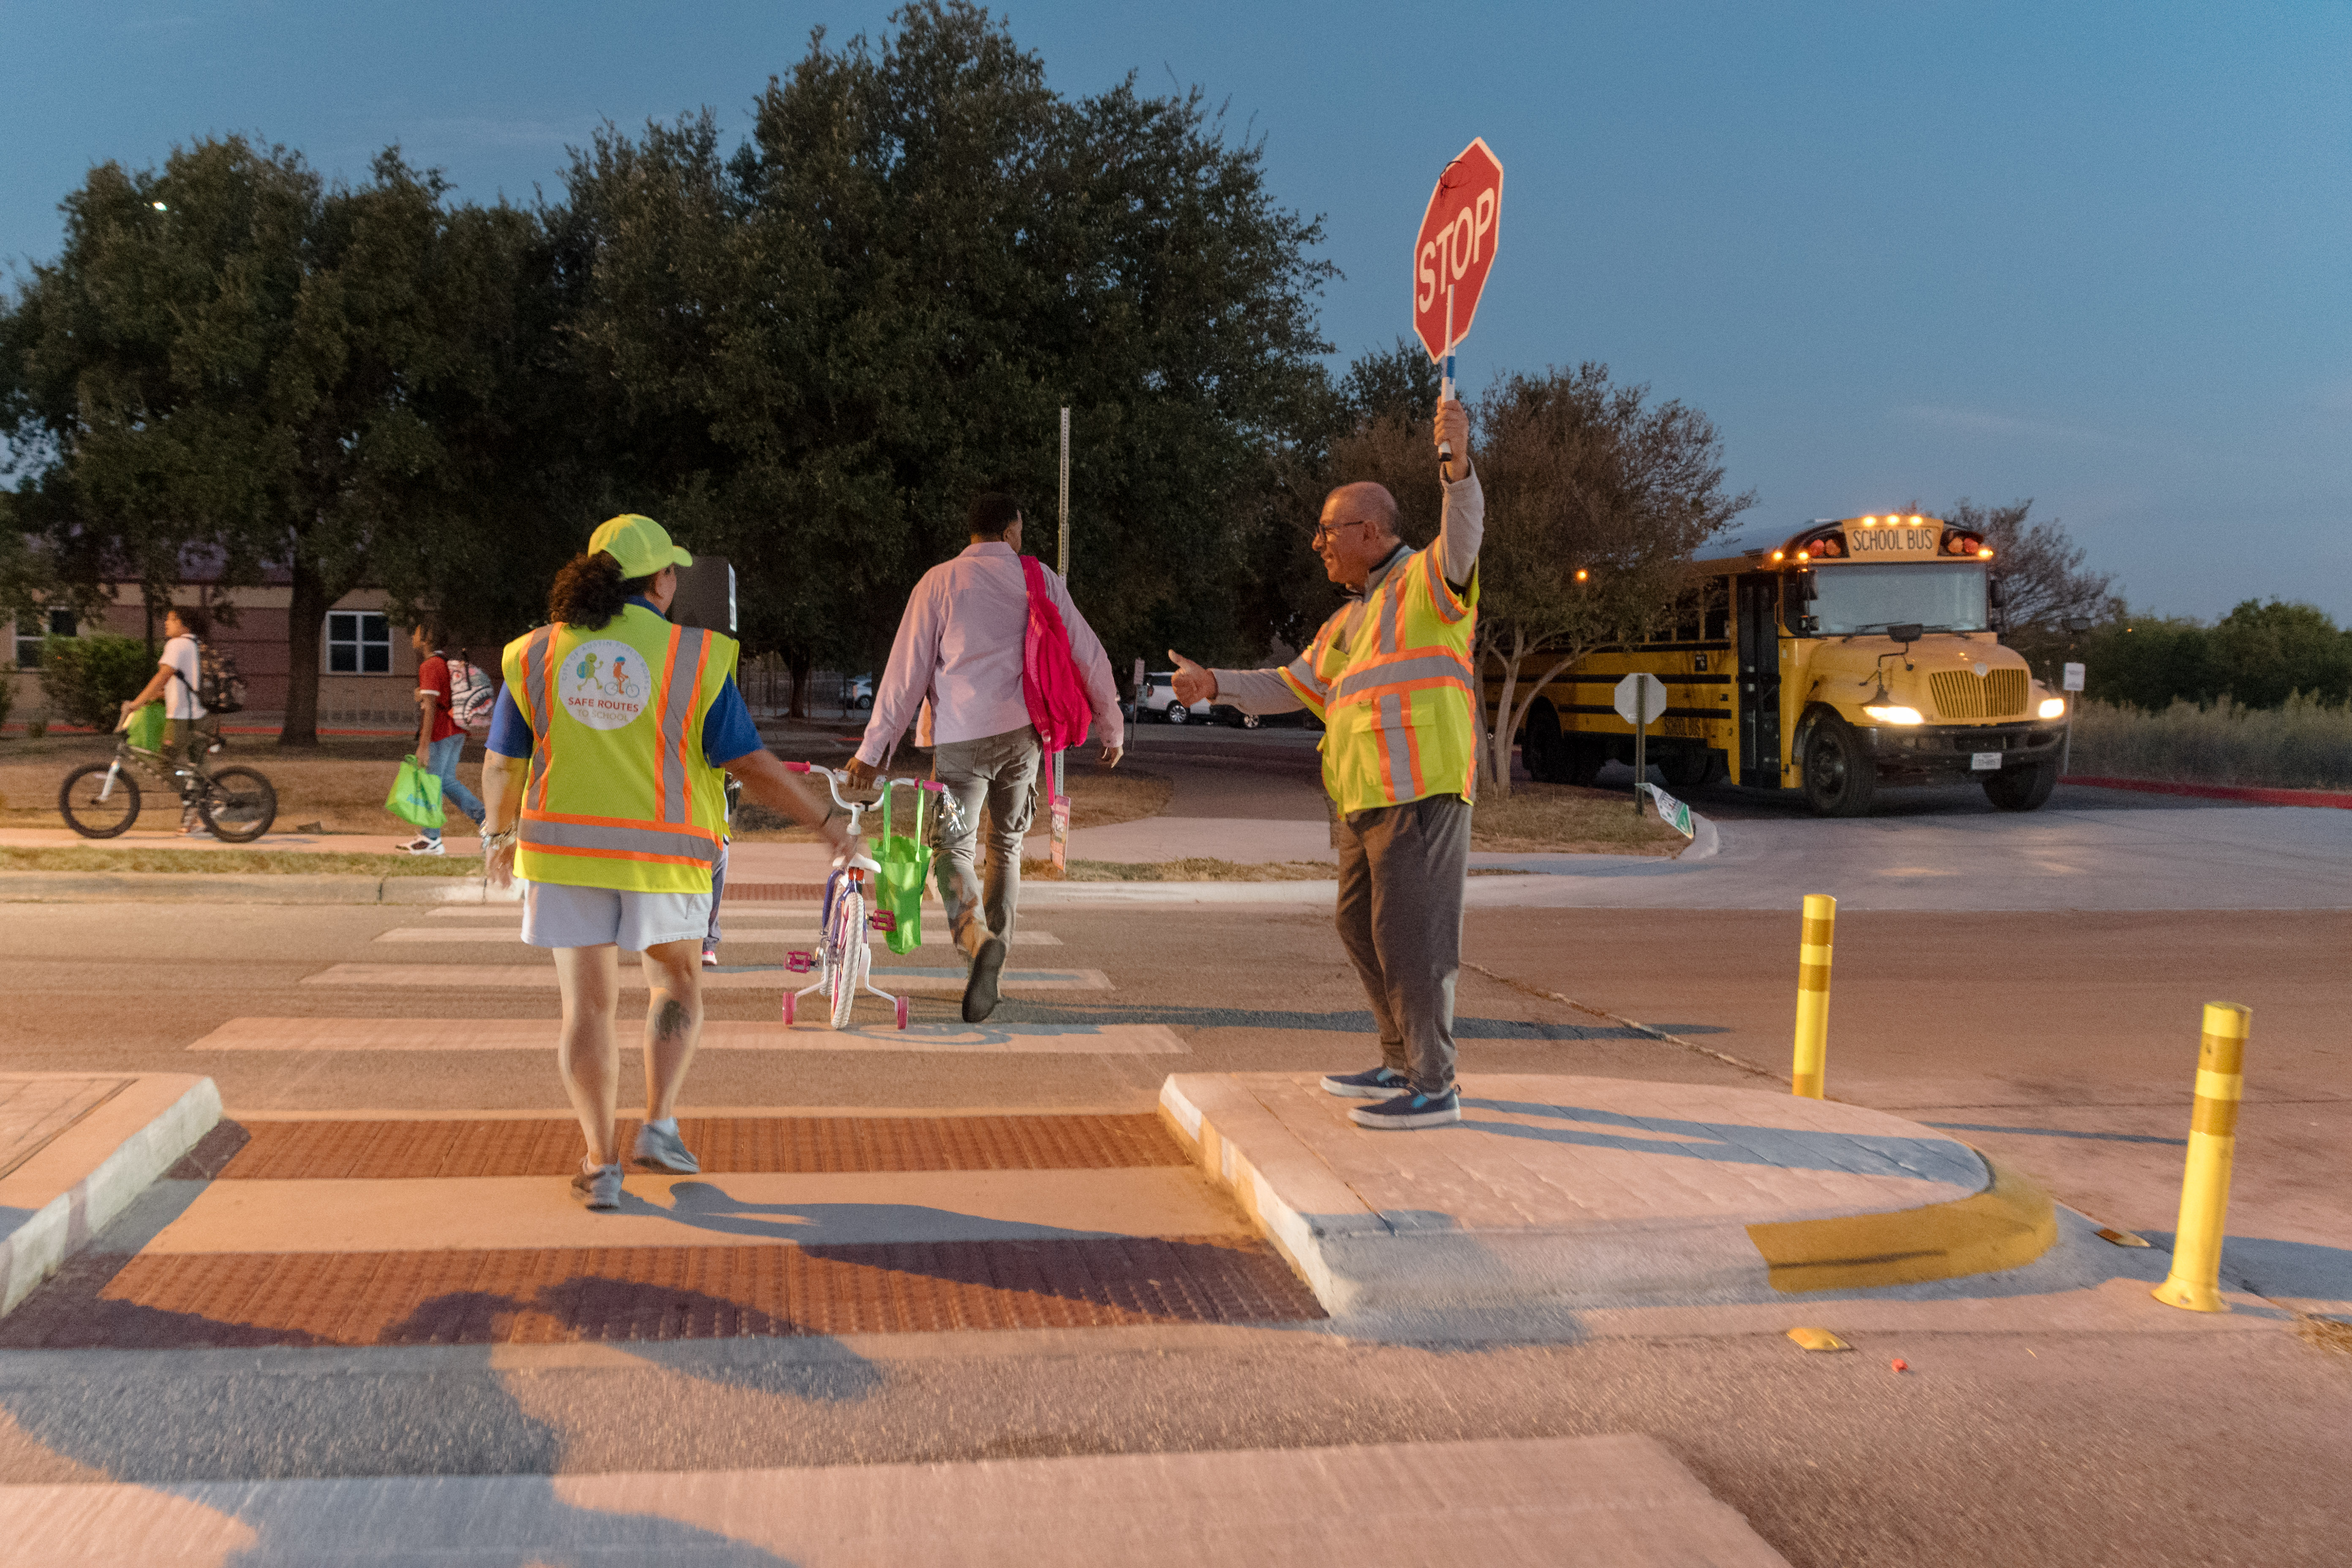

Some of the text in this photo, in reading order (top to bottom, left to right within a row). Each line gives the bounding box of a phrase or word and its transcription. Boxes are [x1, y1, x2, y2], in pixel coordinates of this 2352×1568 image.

[1418, 188, 1495, 313] STOP
[1853, 529, 1933, 551] SCHOOL BUS
[582, 640, 612, 651] AUSTIN
[615, 641, 641, 661] PUBLIC
[568, 697, 639, 713] SAFE ROUTES
[577, 708, 629, 722] TO SCHOOL
